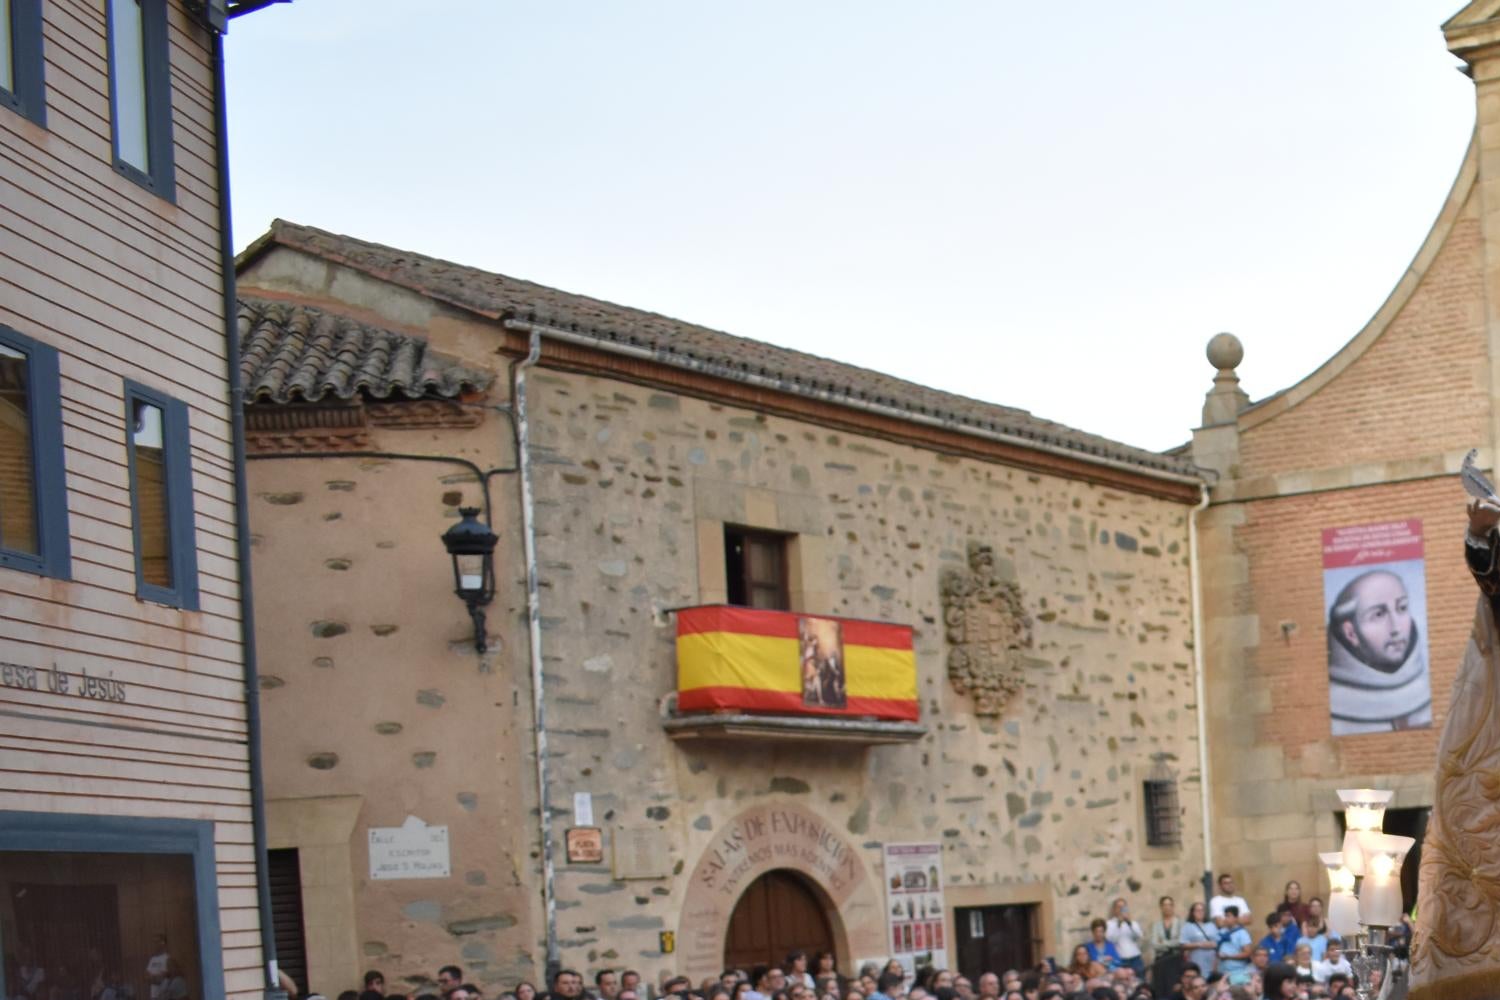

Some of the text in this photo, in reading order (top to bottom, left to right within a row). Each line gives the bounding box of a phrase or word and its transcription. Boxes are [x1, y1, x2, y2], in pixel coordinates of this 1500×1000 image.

[0, 662, 126, 702] esa de Jesús
